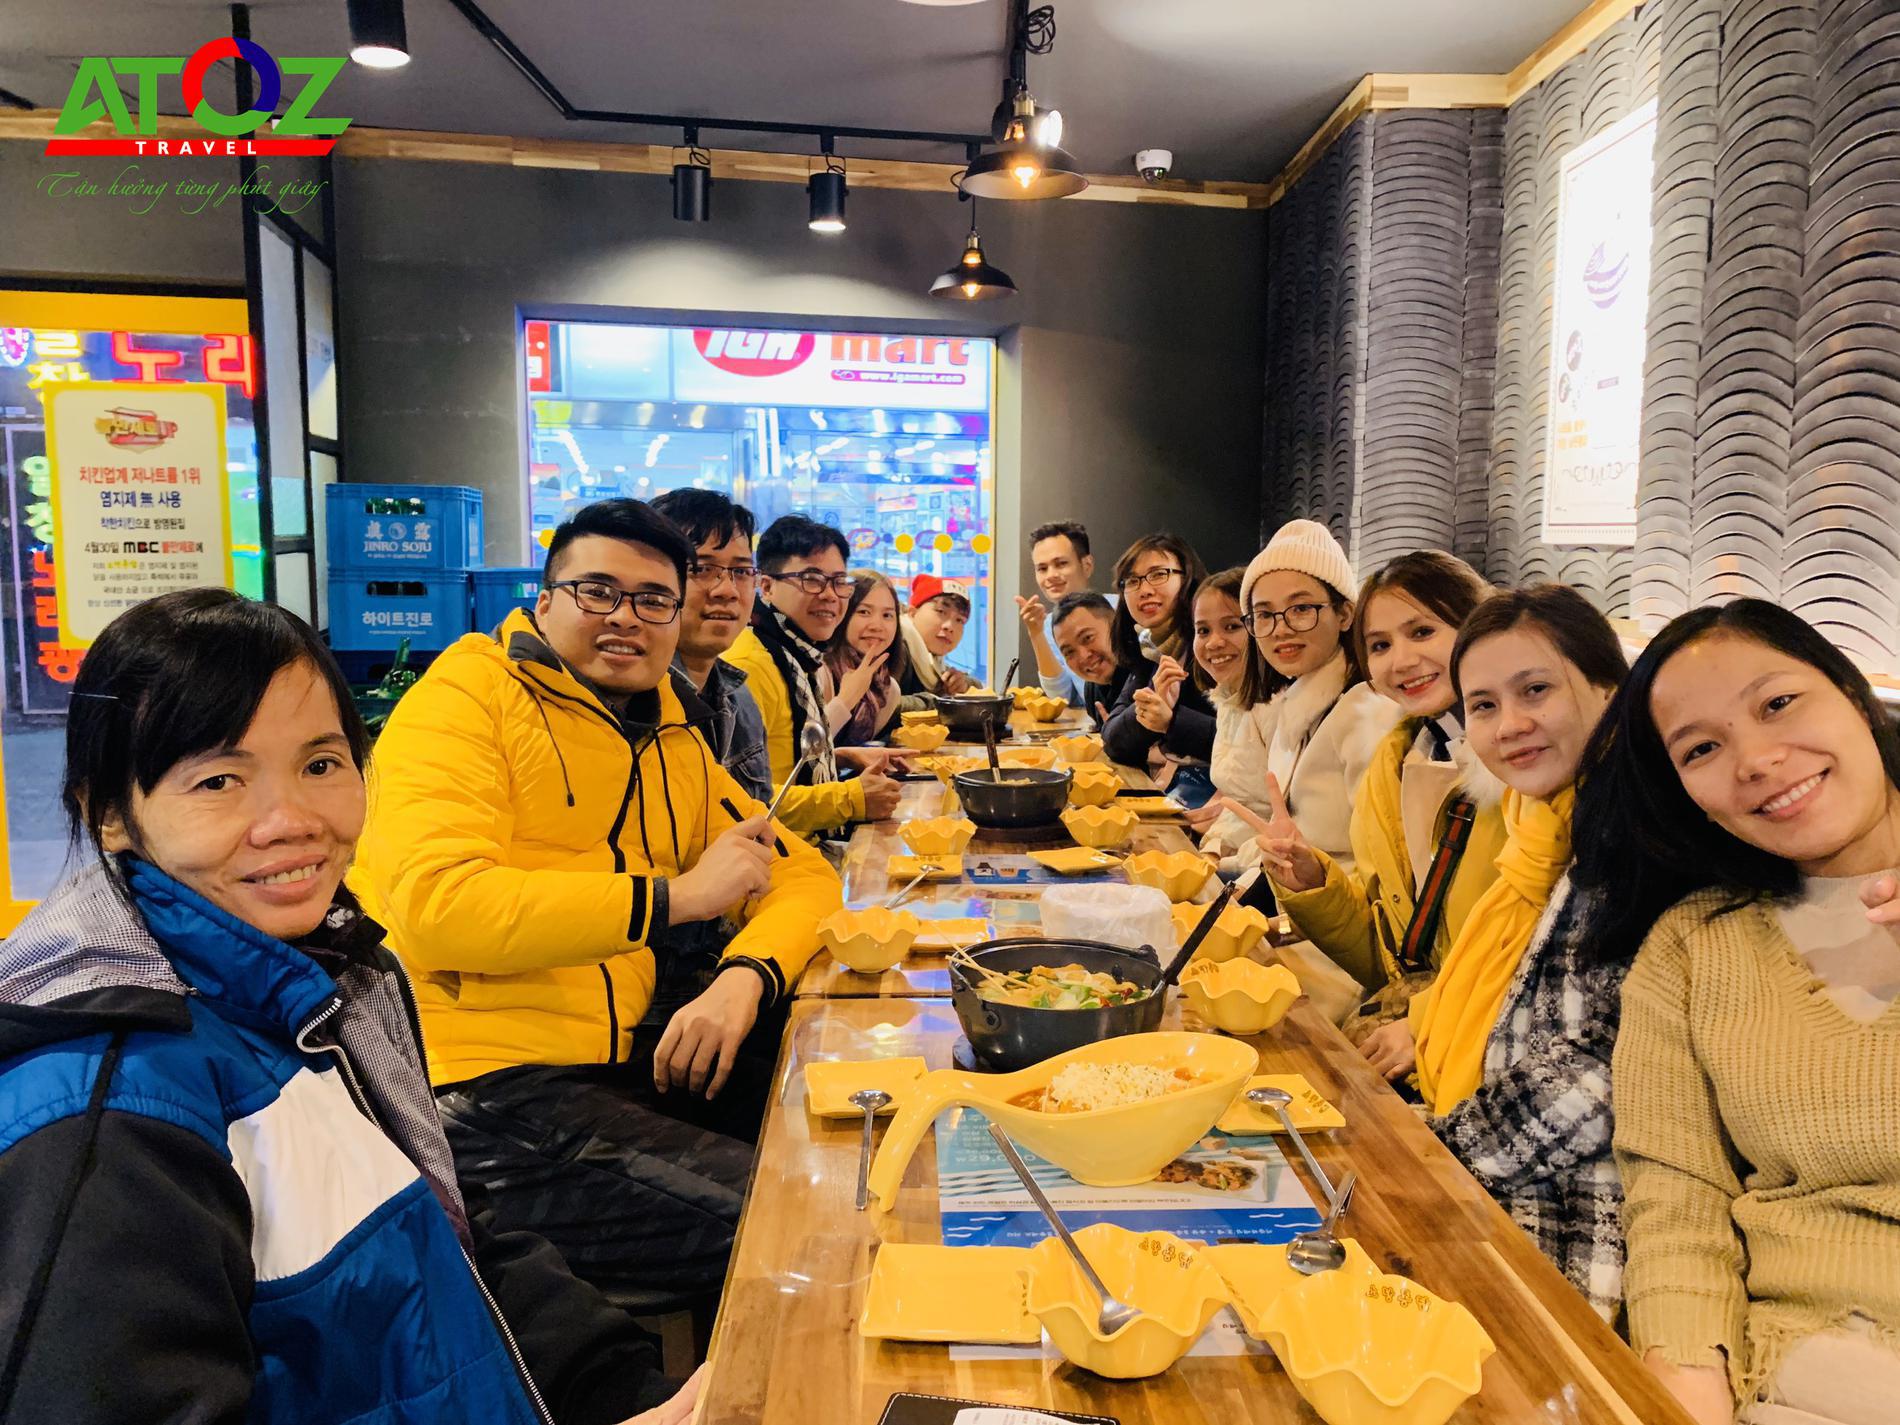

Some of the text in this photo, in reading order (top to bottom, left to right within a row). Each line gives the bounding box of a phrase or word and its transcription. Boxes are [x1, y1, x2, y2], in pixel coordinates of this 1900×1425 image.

[831, 335, 969, 366] mart
[158, 491, 181, 508] 사용
[363, 541, 432, 553] JINRO SOJU
[362, 610, 433, 628] 하이트진로
